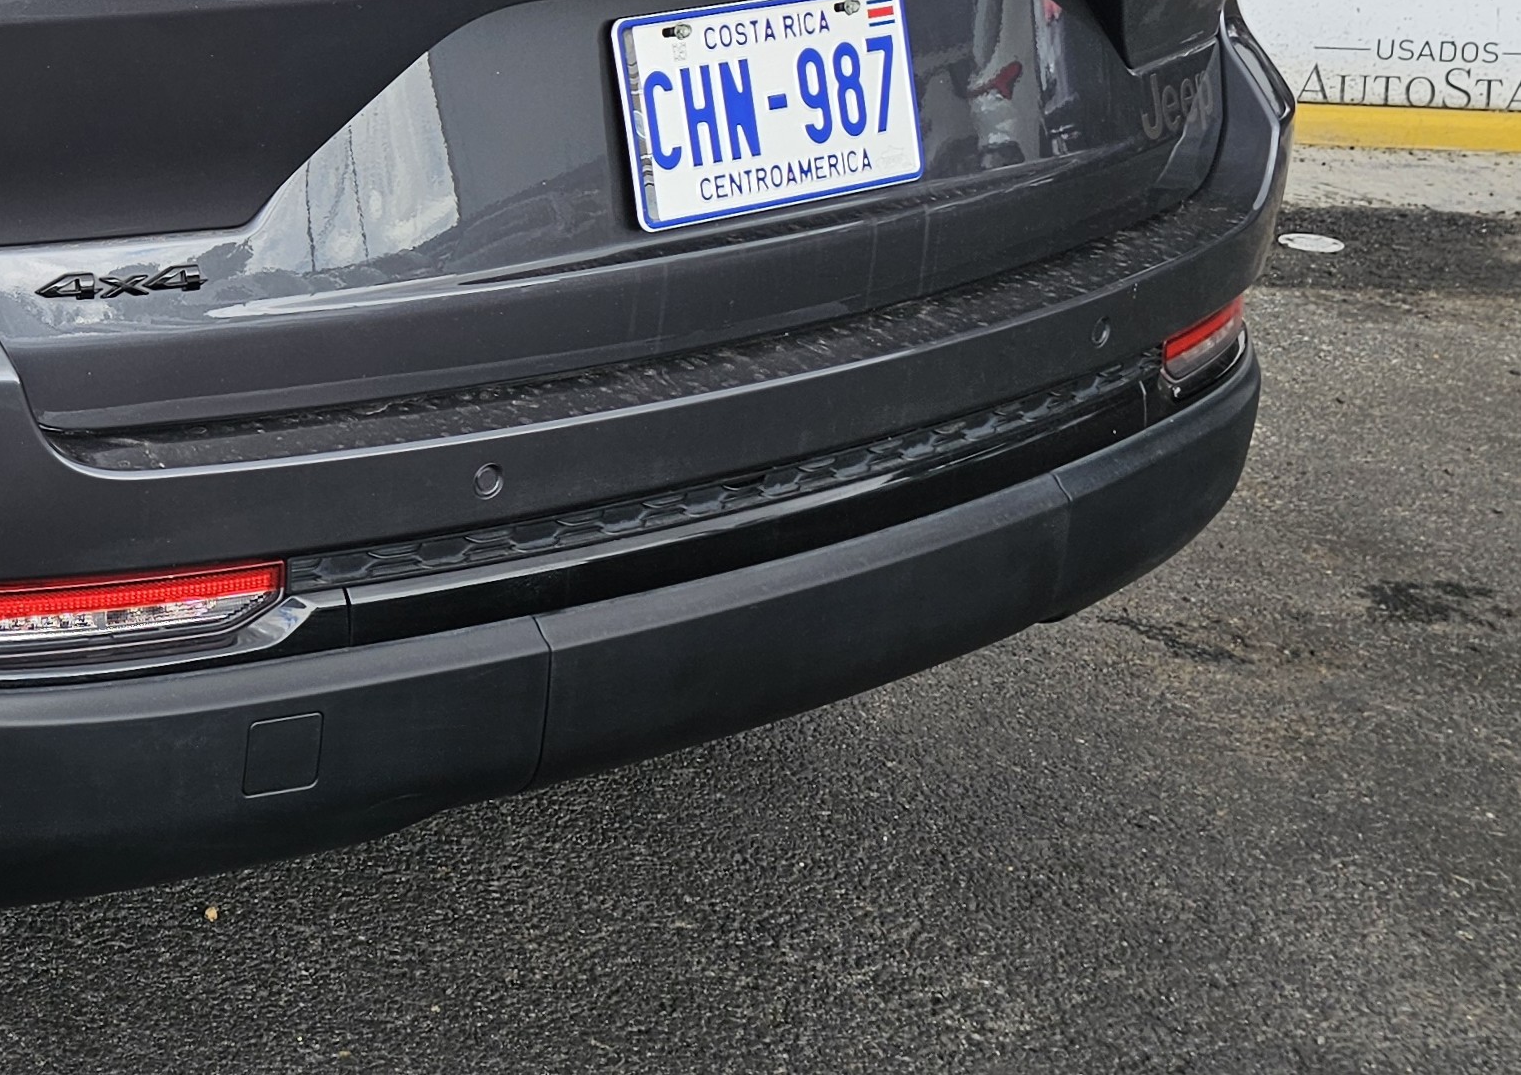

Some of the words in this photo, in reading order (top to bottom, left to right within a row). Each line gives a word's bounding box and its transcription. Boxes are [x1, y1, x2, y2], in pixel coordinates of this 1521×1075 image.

[703, 17, 777, 50] COSTA
[782, 10, 830, 39] RICA
[1376, 38, 1499, 64] USADOS
[643, 34, 893, 170] CHN-987
[1140, 70, 1215, 140] Jeep
[699, 148, 873, 201] CENTROAMERICA
